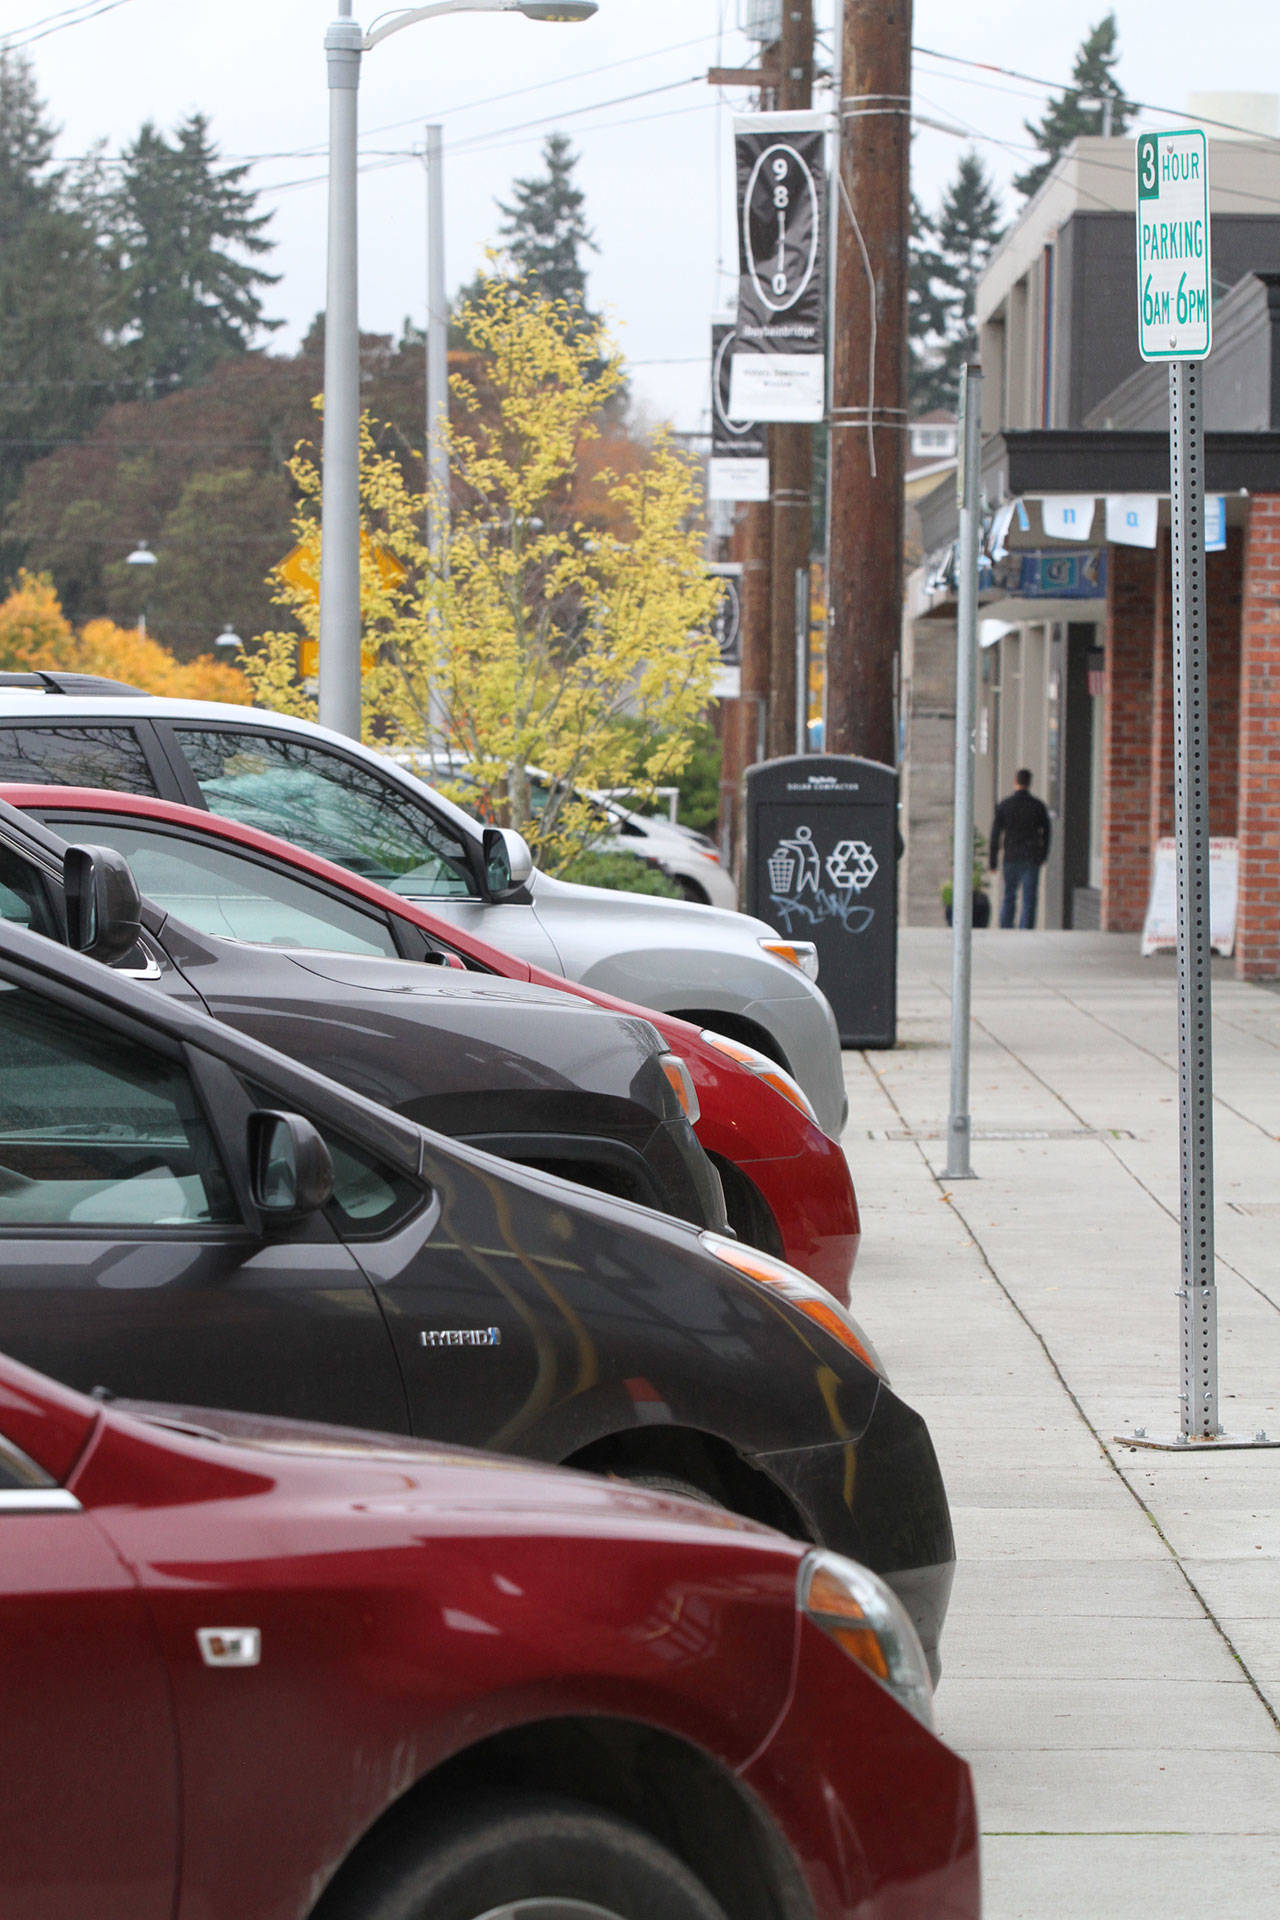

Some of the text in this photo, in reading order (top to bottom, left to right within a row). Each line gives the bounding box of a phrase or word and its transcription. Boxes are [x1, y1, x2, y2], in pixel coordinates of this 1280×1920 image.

[1142, 142, 1200, 189] 3 HOUR
[1143, 220, 1203, 261] PARKING
[421, 1329, 488, 1347] HYBRID
